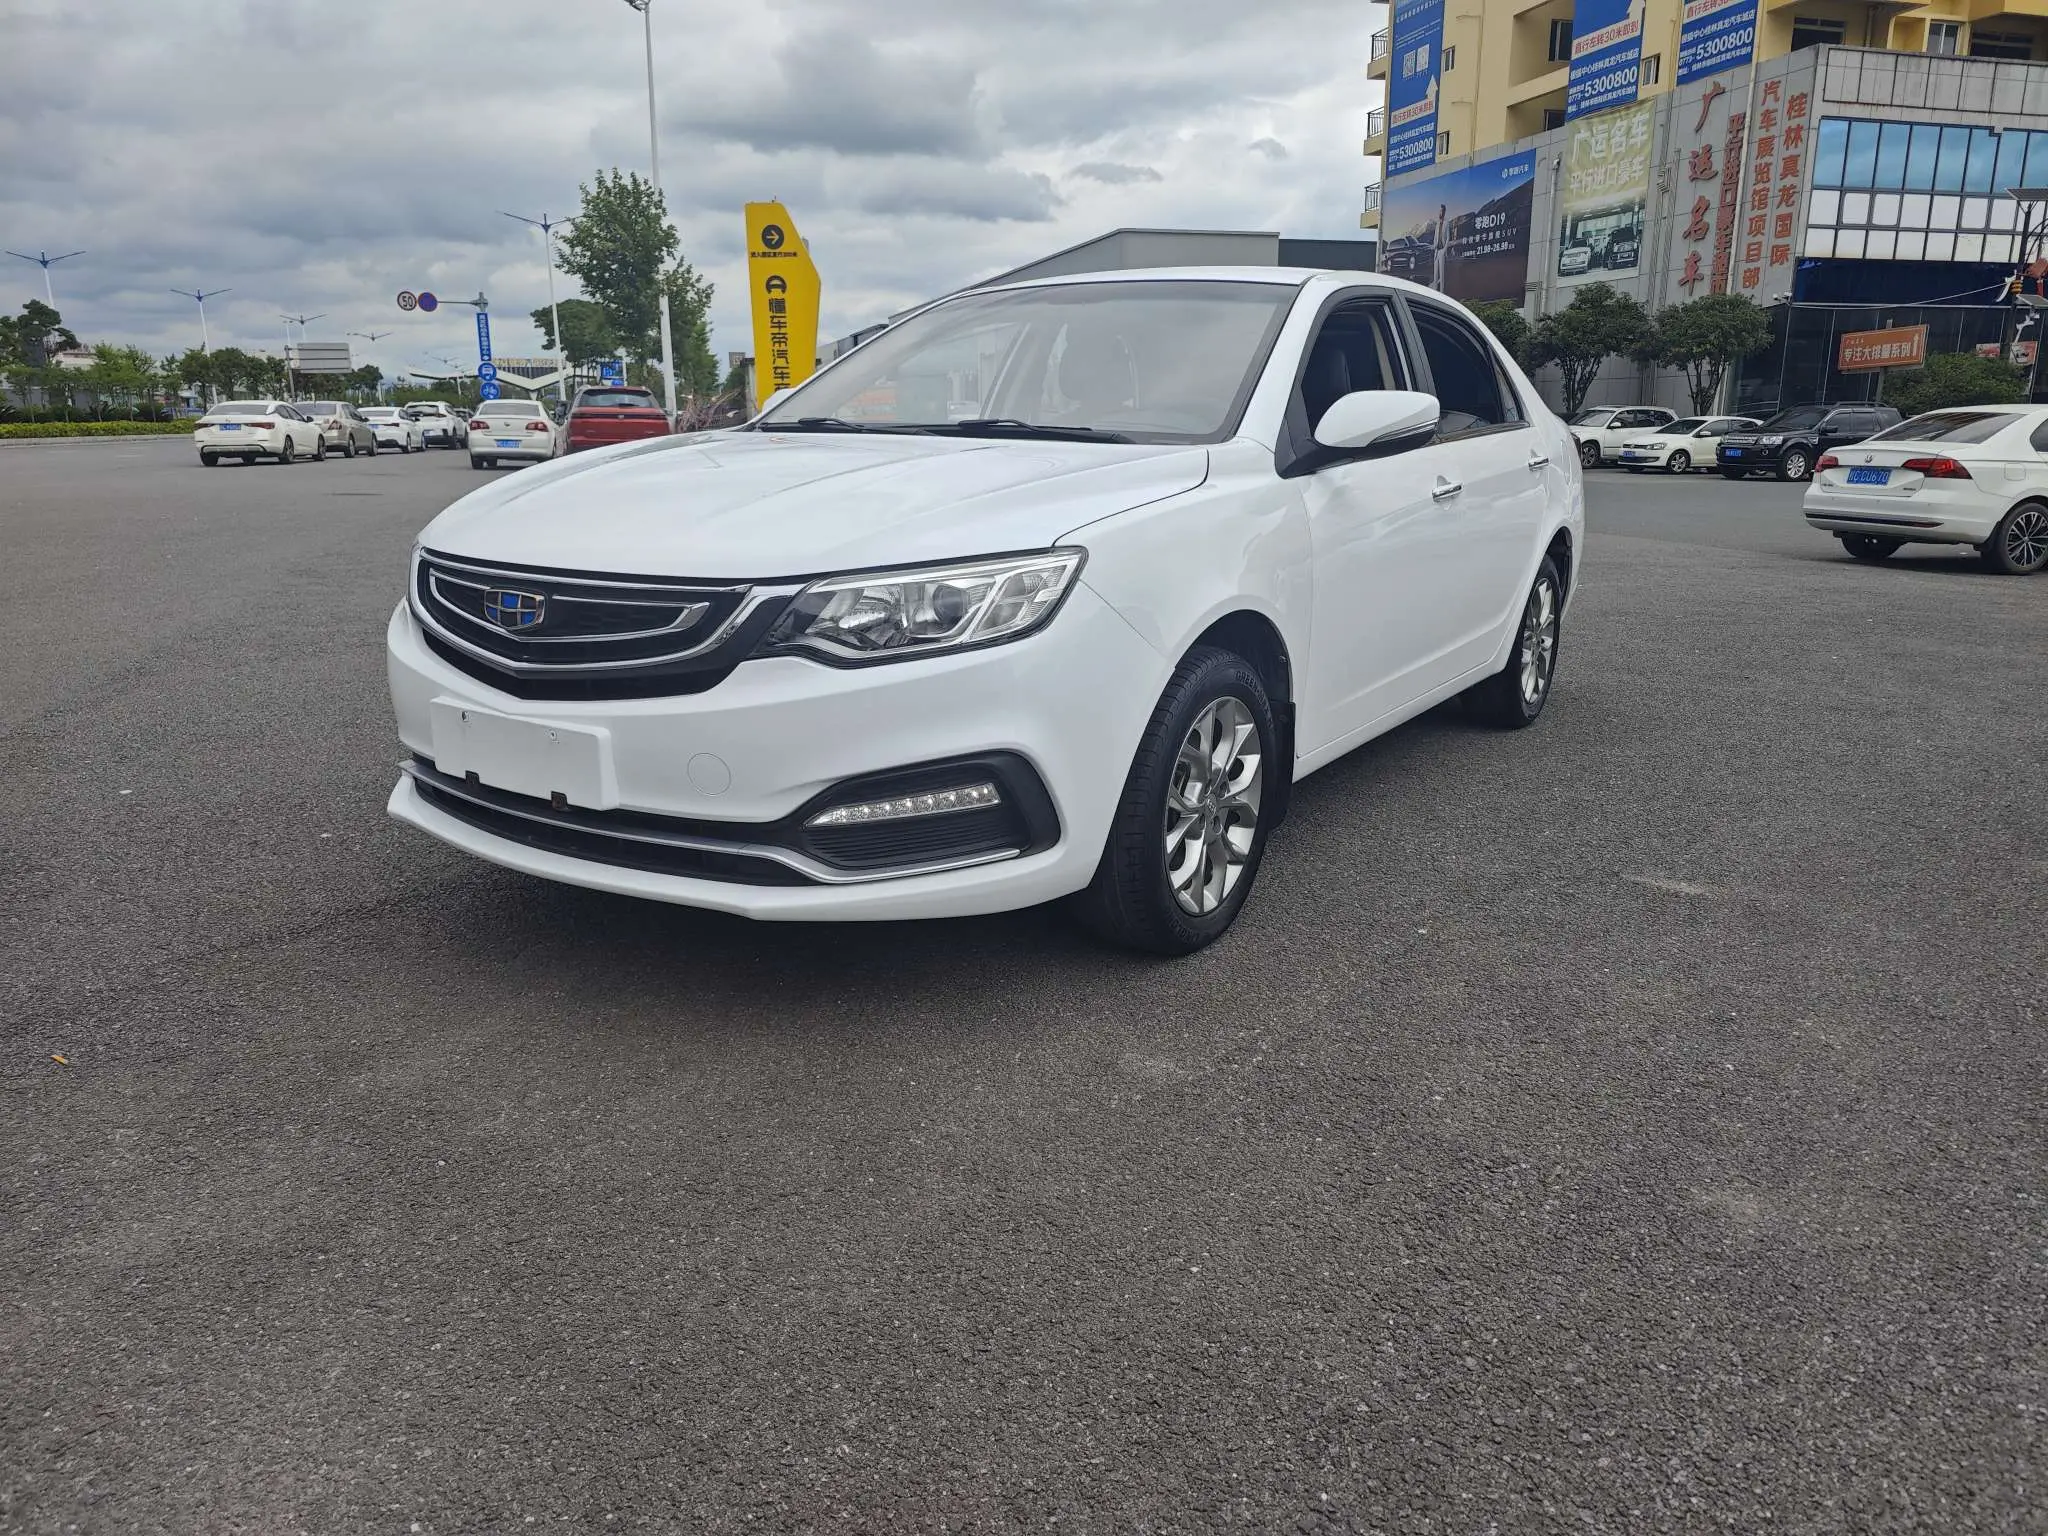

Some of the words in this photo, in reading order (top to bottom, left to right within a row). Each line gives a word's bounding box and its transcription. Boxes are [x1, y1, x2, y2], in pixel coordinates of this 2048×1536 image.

[1584, 66, 1638, 97] 5300800
[1571, 111, 1650, 163] 广运名车
[1570, 155, 1645, 194] 平行进口豪车
[1742, 80, 1781, 290] 汽车展览馆项目部
[1770, 92, 1808, 266] 桂林真龙国际
[401, 295, 414, 307] 50
